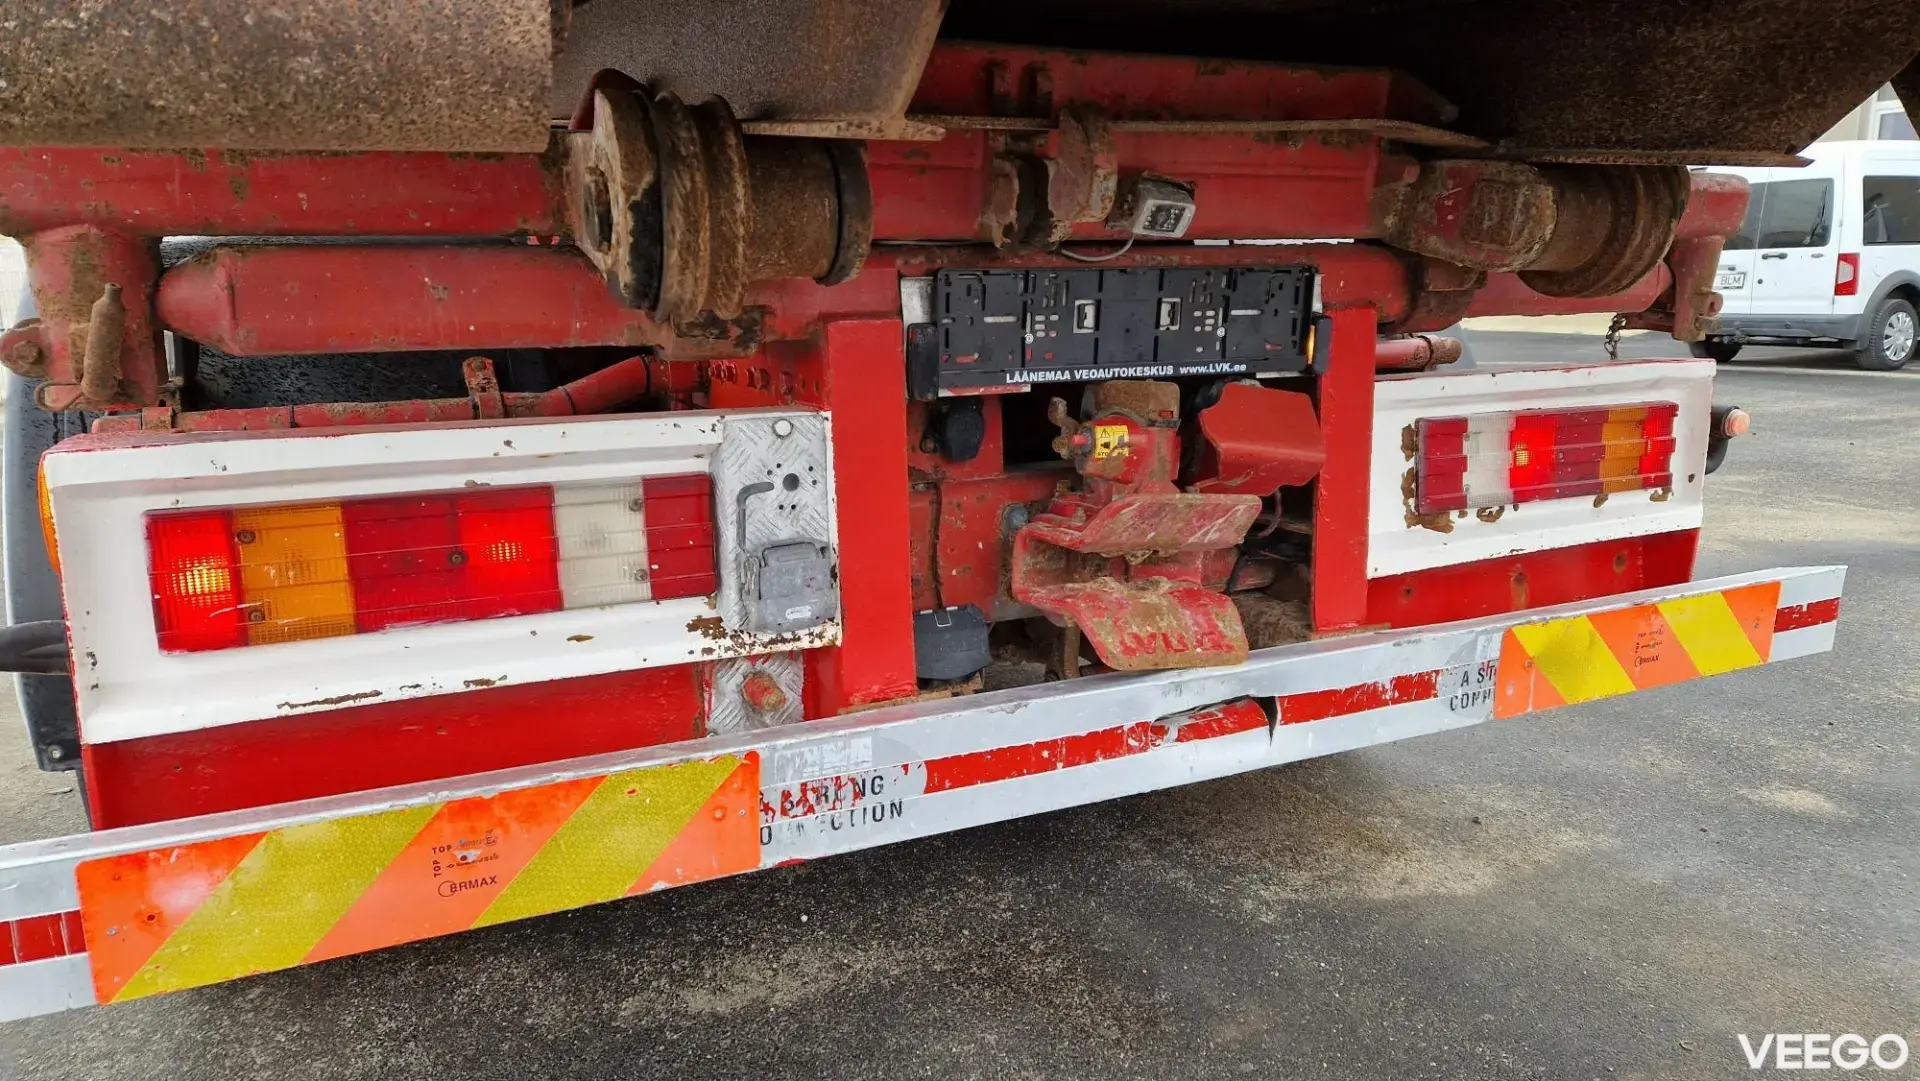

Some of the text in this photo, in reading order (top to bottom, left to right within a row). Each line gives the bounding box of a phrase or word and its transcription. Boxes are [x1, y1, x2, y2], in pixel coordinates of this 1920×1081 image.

[1006, 362, 1247, 383] LÄÄNEMAA VEOAUTOKESKUS www.LVK.ee
[1460, 665, 1495, 687] A ST
[432, 844, 453, 855] TOP
[432, 859, 442, 878] TOP
